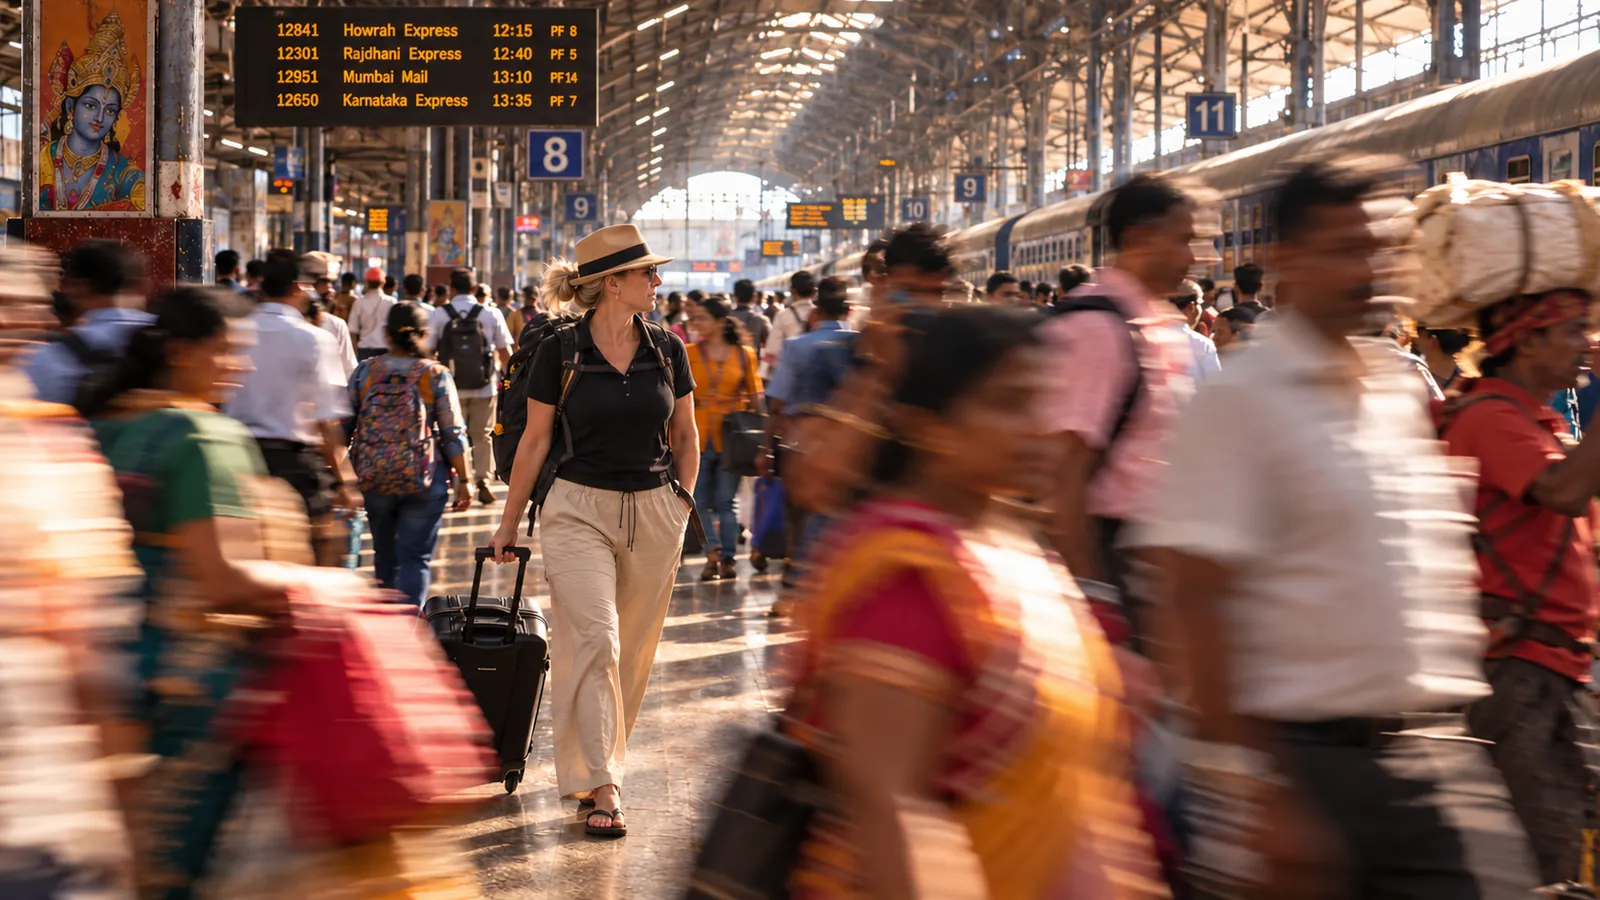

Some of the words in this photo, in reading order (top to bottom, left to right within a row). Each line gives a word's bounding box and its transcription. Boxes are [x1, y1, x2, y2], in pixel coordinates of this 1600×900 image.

[277, 23, 319, 37] 12841
[343, 23, 396, 37] Howrah
[404, 23, 459, 40] Express
[493, 23, 533, 37] 12:15
[550, 25, 565, 37] PF
[569, 25, 578, 37] 8
[277, 46, 319, 61] 12301
[343, 46, 401, 63] Rajdhani
[408, 46, 462, 63] Express
[493, 46, 533, 61] 12:40
[550, 48, 565, 61] PF
[569, 48, 578, 61] 5
[277, 69, 319, 84] 12951
[343, 69, 395, 84] Mumbai
[401, 69, 429, 84] Mail
[493, 70, 533, 84] 13:10
[277, 93, 319, 107] 12650
[342, 93, 408, 107] Karnataka
[415, 93, 469, 109] Express
[493, 93, 533, 108] 13:35
[549, 95, 565, 108] PF
[569, 95, 578, 107] 7
[1195, 100, 1224, 132] 11
[543, 136, 569, 173] 8
[963, 177, 977, 197] 9
[574, 197, 589, 219] 9
[906, 201, 924, 218] 10
